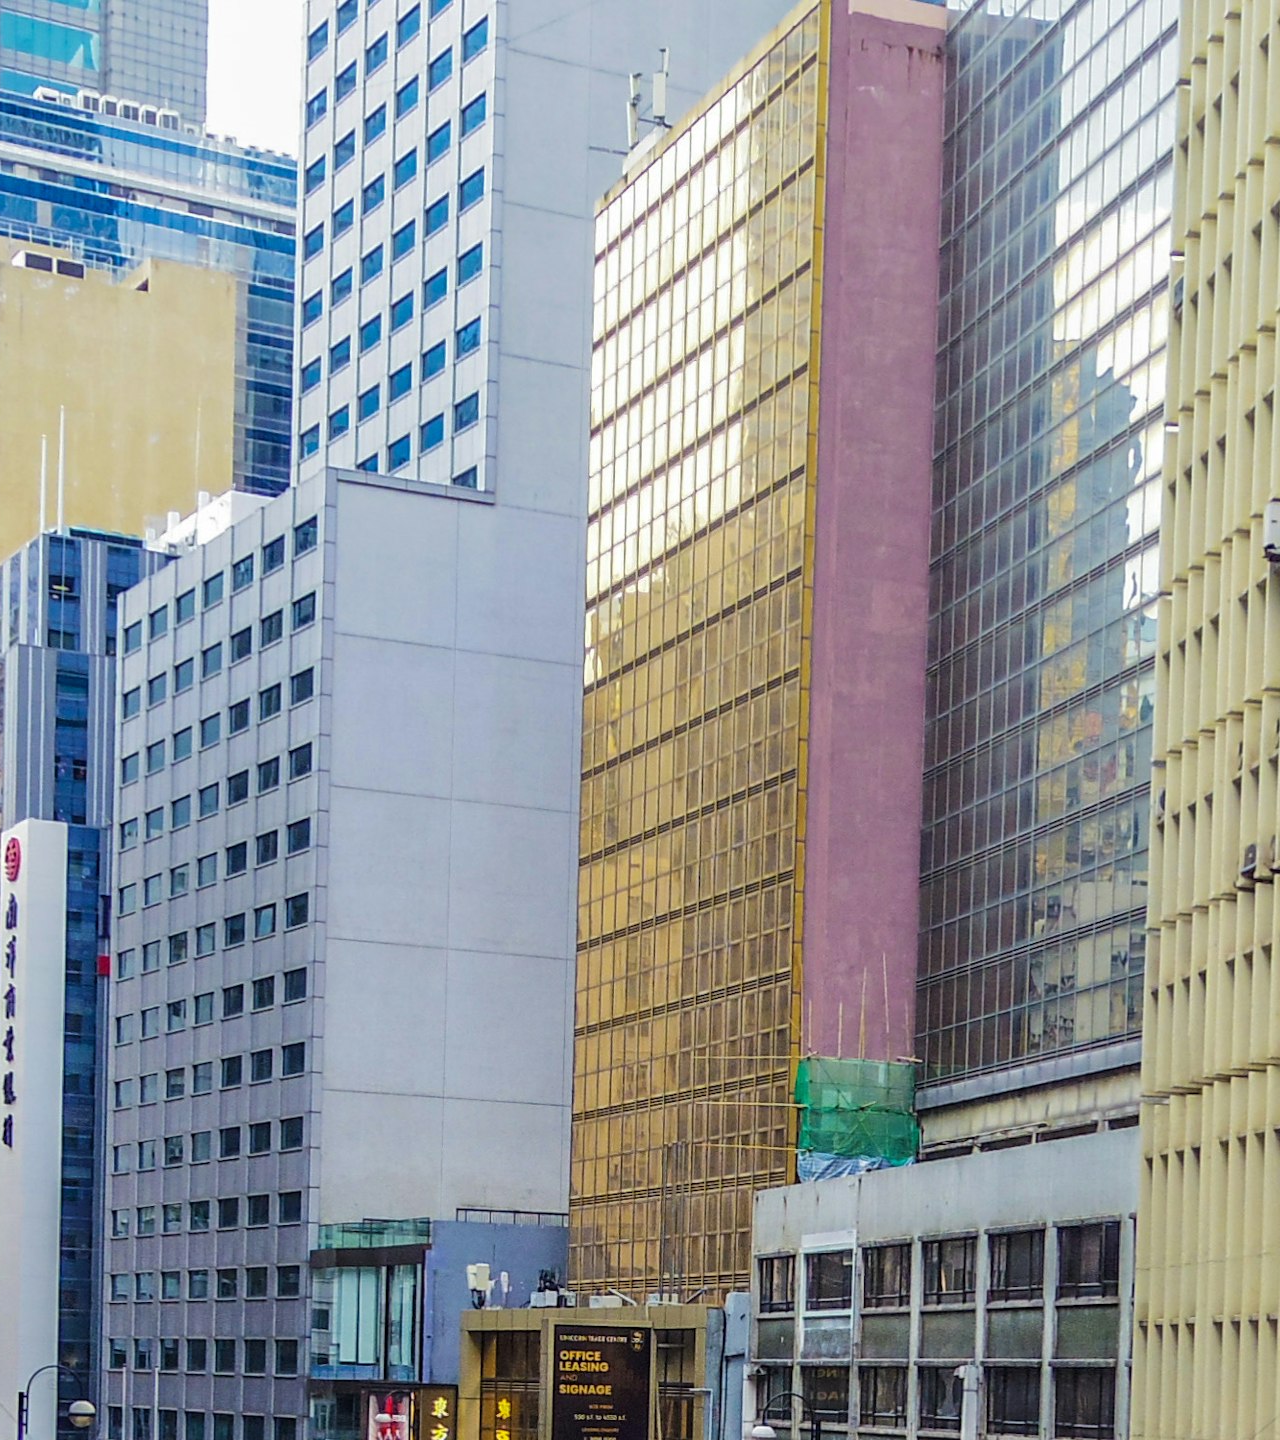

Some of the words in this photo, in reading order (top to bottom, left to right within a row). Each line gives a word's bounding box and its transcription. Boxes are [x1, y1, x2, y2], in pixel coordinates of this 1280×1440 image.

[560, 1350, 601, 1361] OFFICE
[560, 1361, 609, 1372] LEASING
[559, 1384, 612, 1395] SIGNAGE
